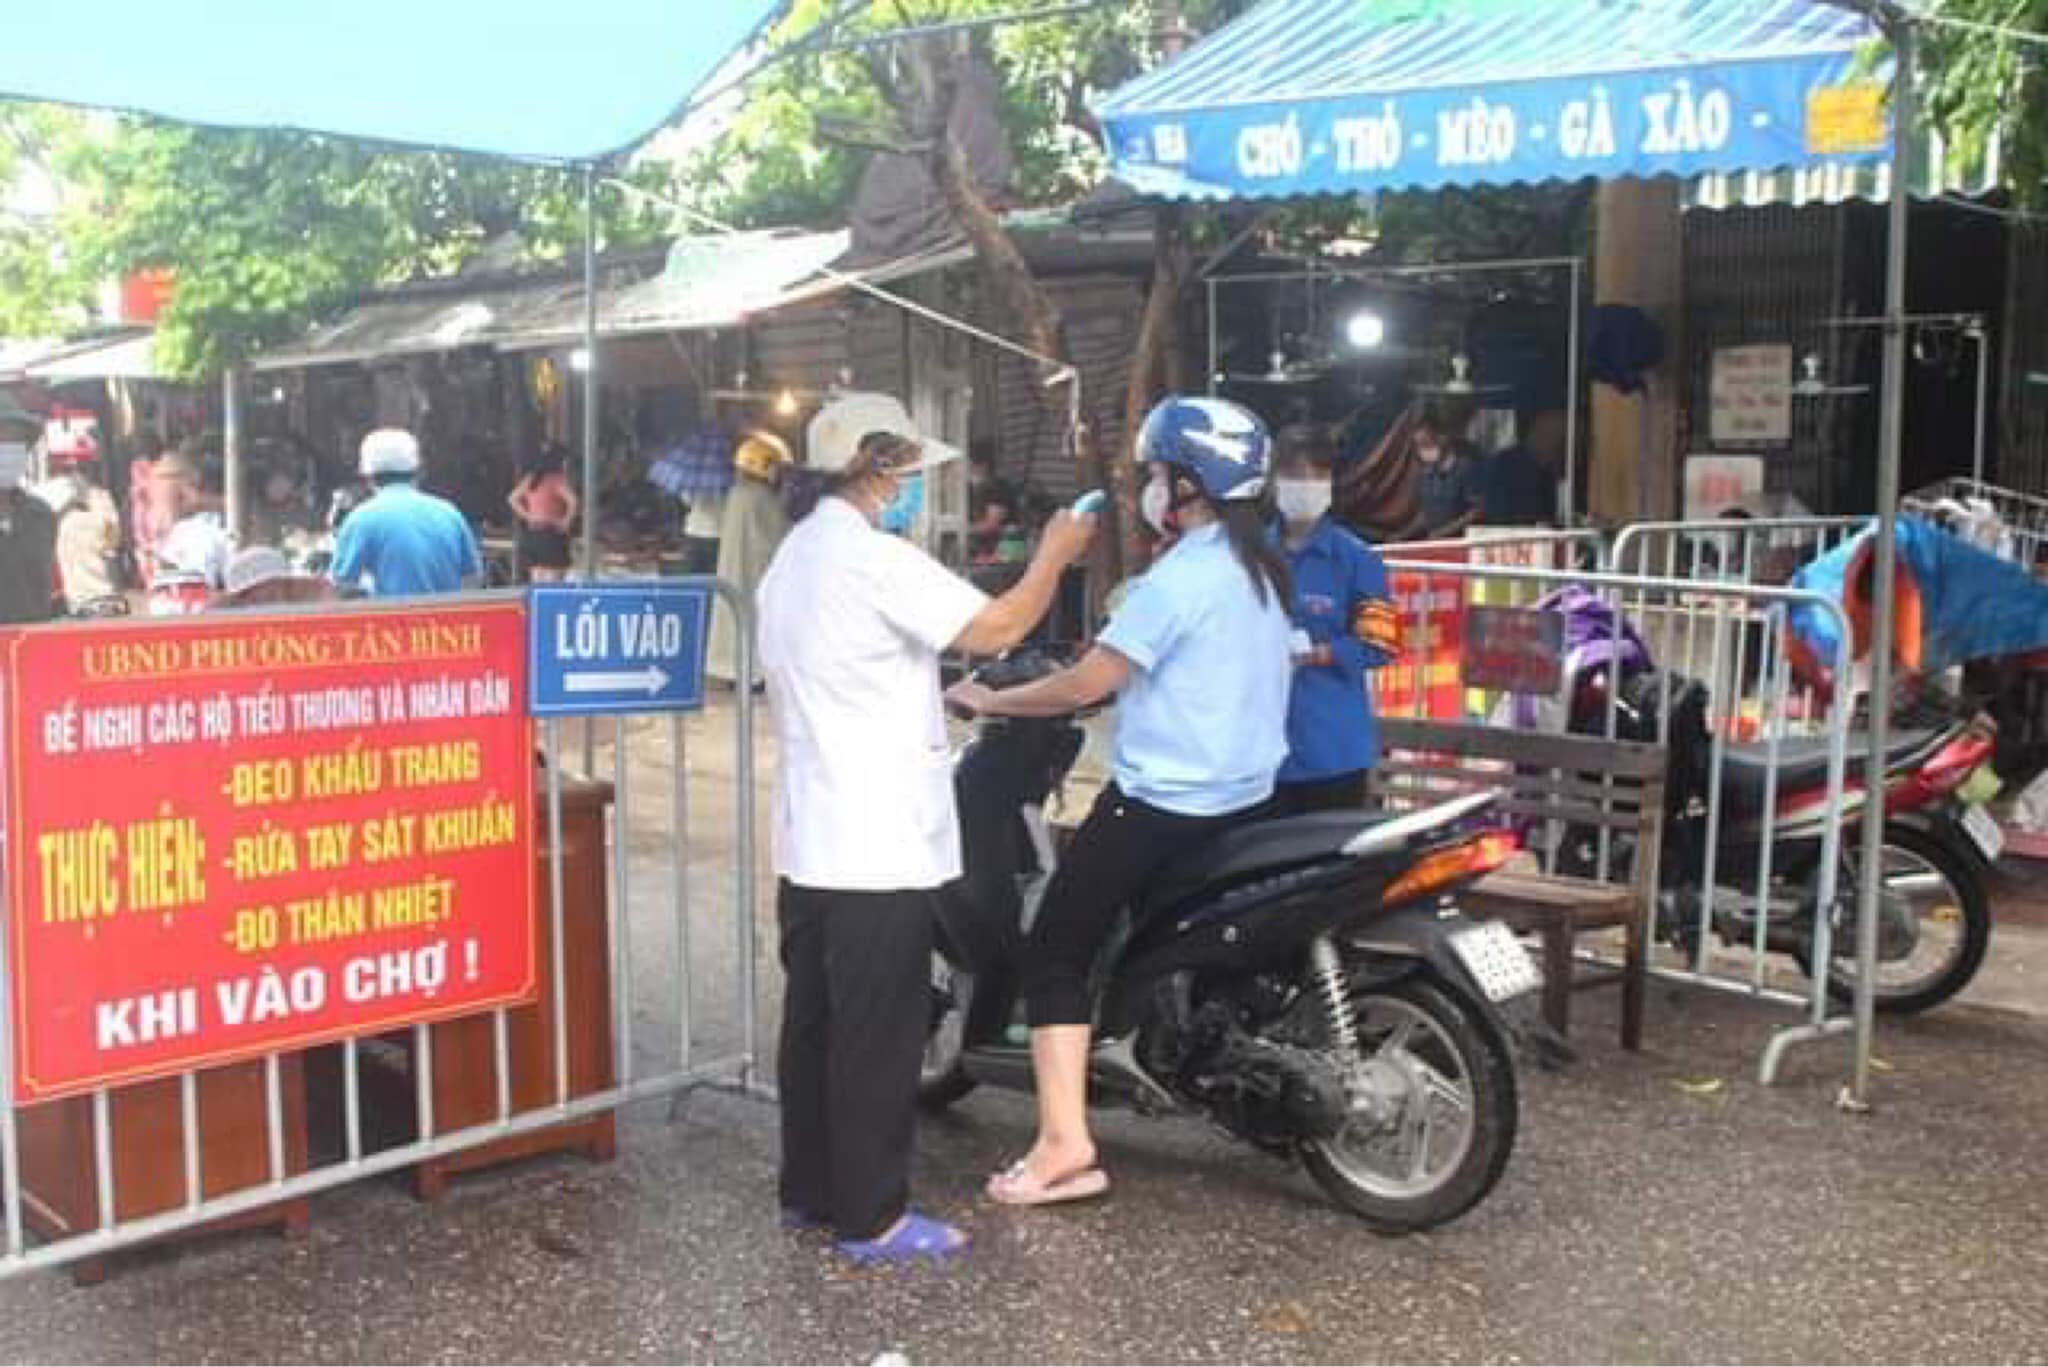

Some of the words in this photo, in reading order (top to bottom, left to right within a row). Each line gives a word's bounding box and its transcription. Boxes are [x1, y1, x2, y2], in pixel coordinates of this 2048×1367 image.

[82, 640, 181, 677] UBND
[340, 622, 402, 663] TÂN
[408, 618, 482, 659] BÌNH
[556, 597, 610, 659] LỐI
[617, 602, 682, 659] VÀO
[409, 672, 465, 719] NHÂN
[391, 741, 481, 788] TRANG
[306, 823, 353, 870] TAY
[38, 818, 119, 941] THỰC
[287, 888, 365, 944] THÂN
[96, 988, 198, 1051] KHI
[216, 964, 327, 1026] VÀO
[343, 940, 448, 998] CHỢ
